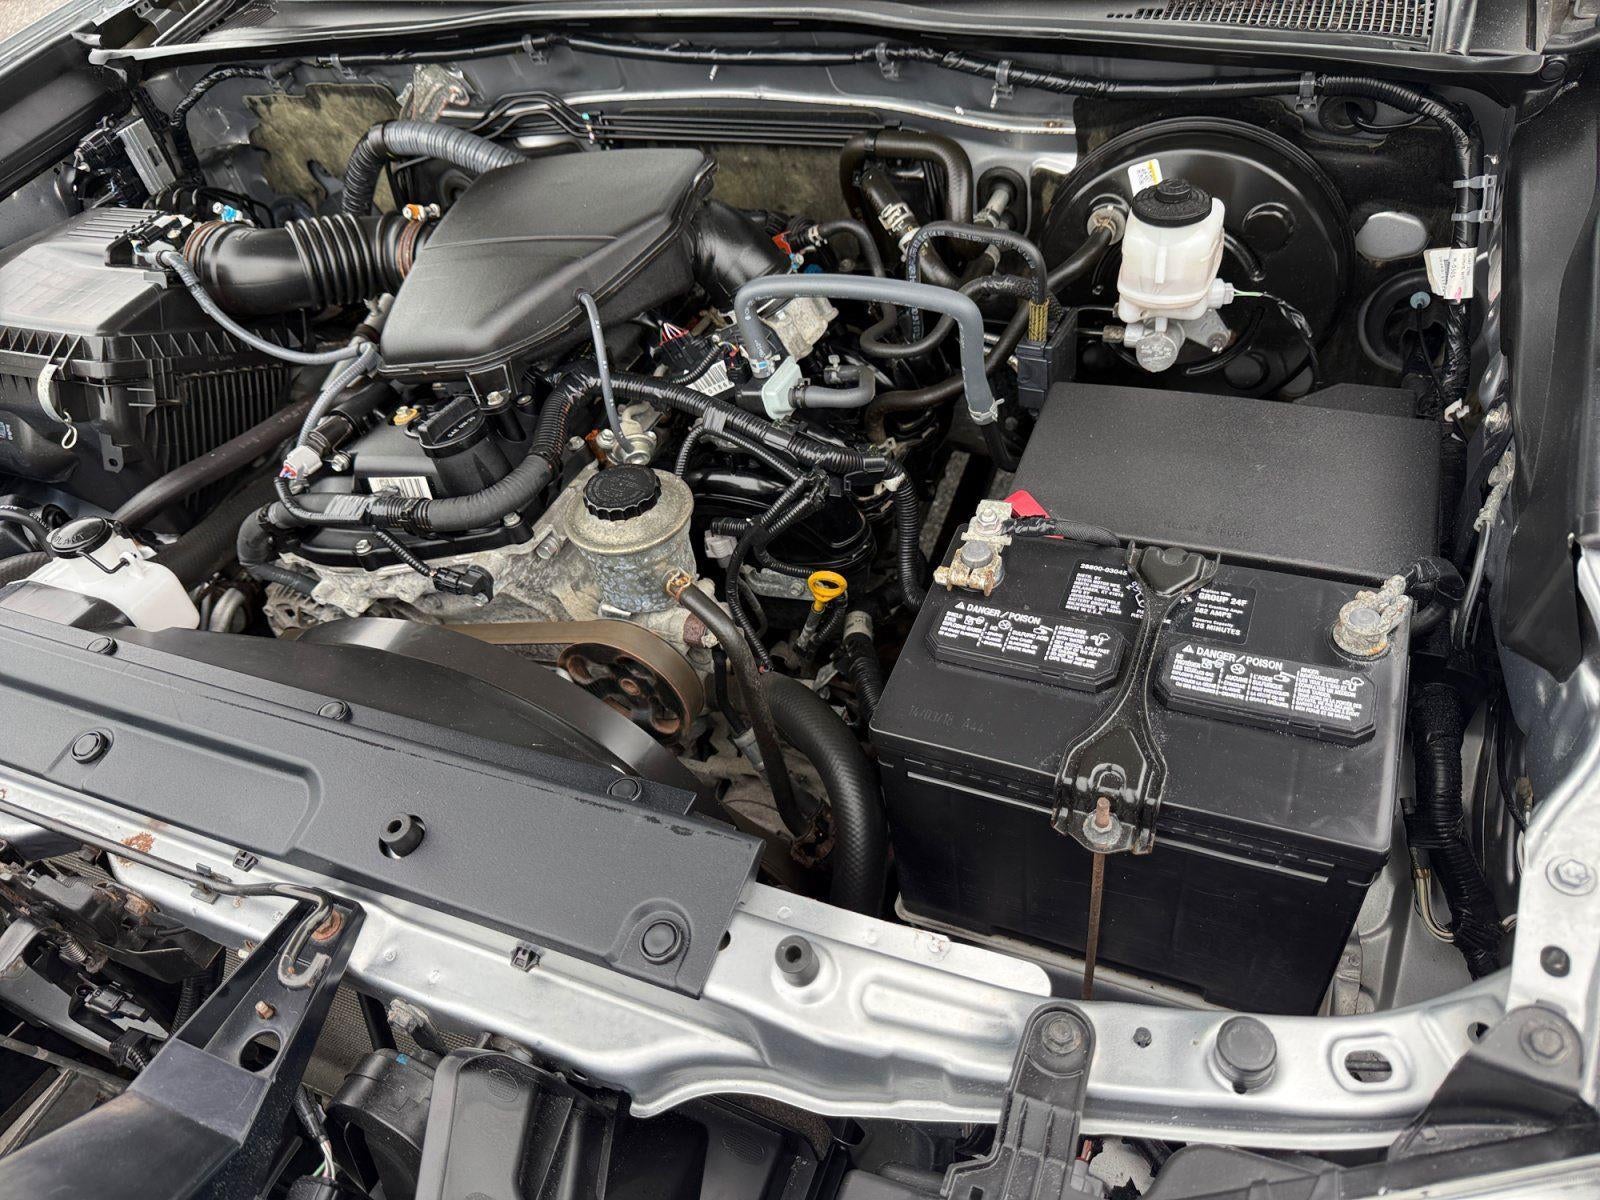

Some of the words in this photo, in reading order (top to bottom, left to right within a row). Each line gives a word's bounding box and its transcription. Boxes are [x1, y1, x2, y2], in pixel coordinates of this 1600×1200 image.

[1198, 593, 1229, 603] GROUP
[1230, 598, 1248, 606] 24F
[1210, 610, 1232, 618] AMPS
[1206, 624, 1240, 636] MINUTES
